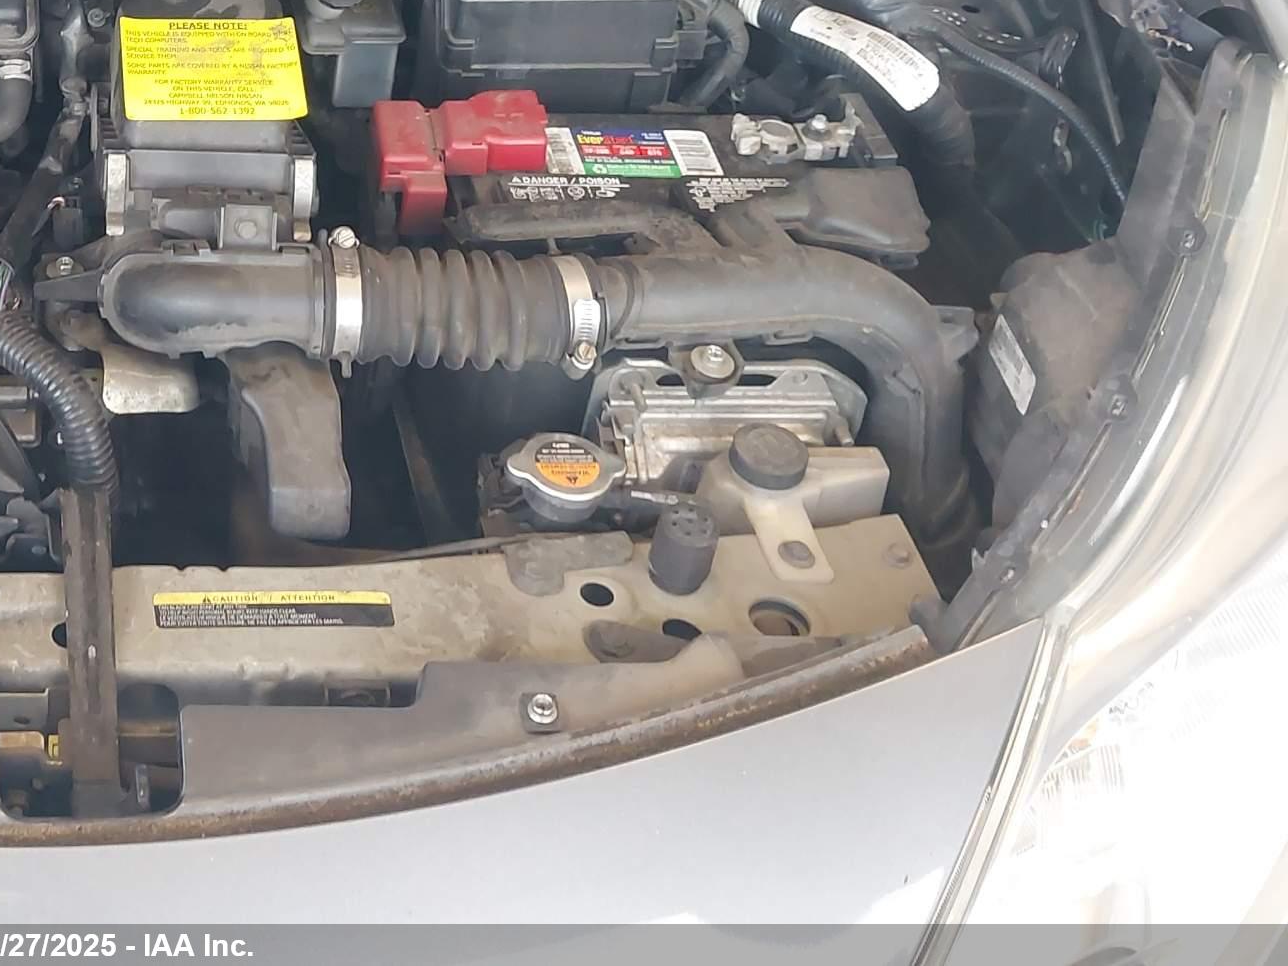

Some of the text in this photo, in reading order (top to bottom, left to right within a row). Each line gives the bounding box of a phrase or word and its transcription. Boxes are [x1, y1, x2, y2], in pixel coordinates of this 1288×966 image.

[169, 22, 248, 31] PLEASE NOTE:
[522, 176, 568, 185] DANGER
[578, 177, 621, 185] POISON
[213, 594, 258, 602] CAUTION
[280, 594, 335, 602] ATTENTION
